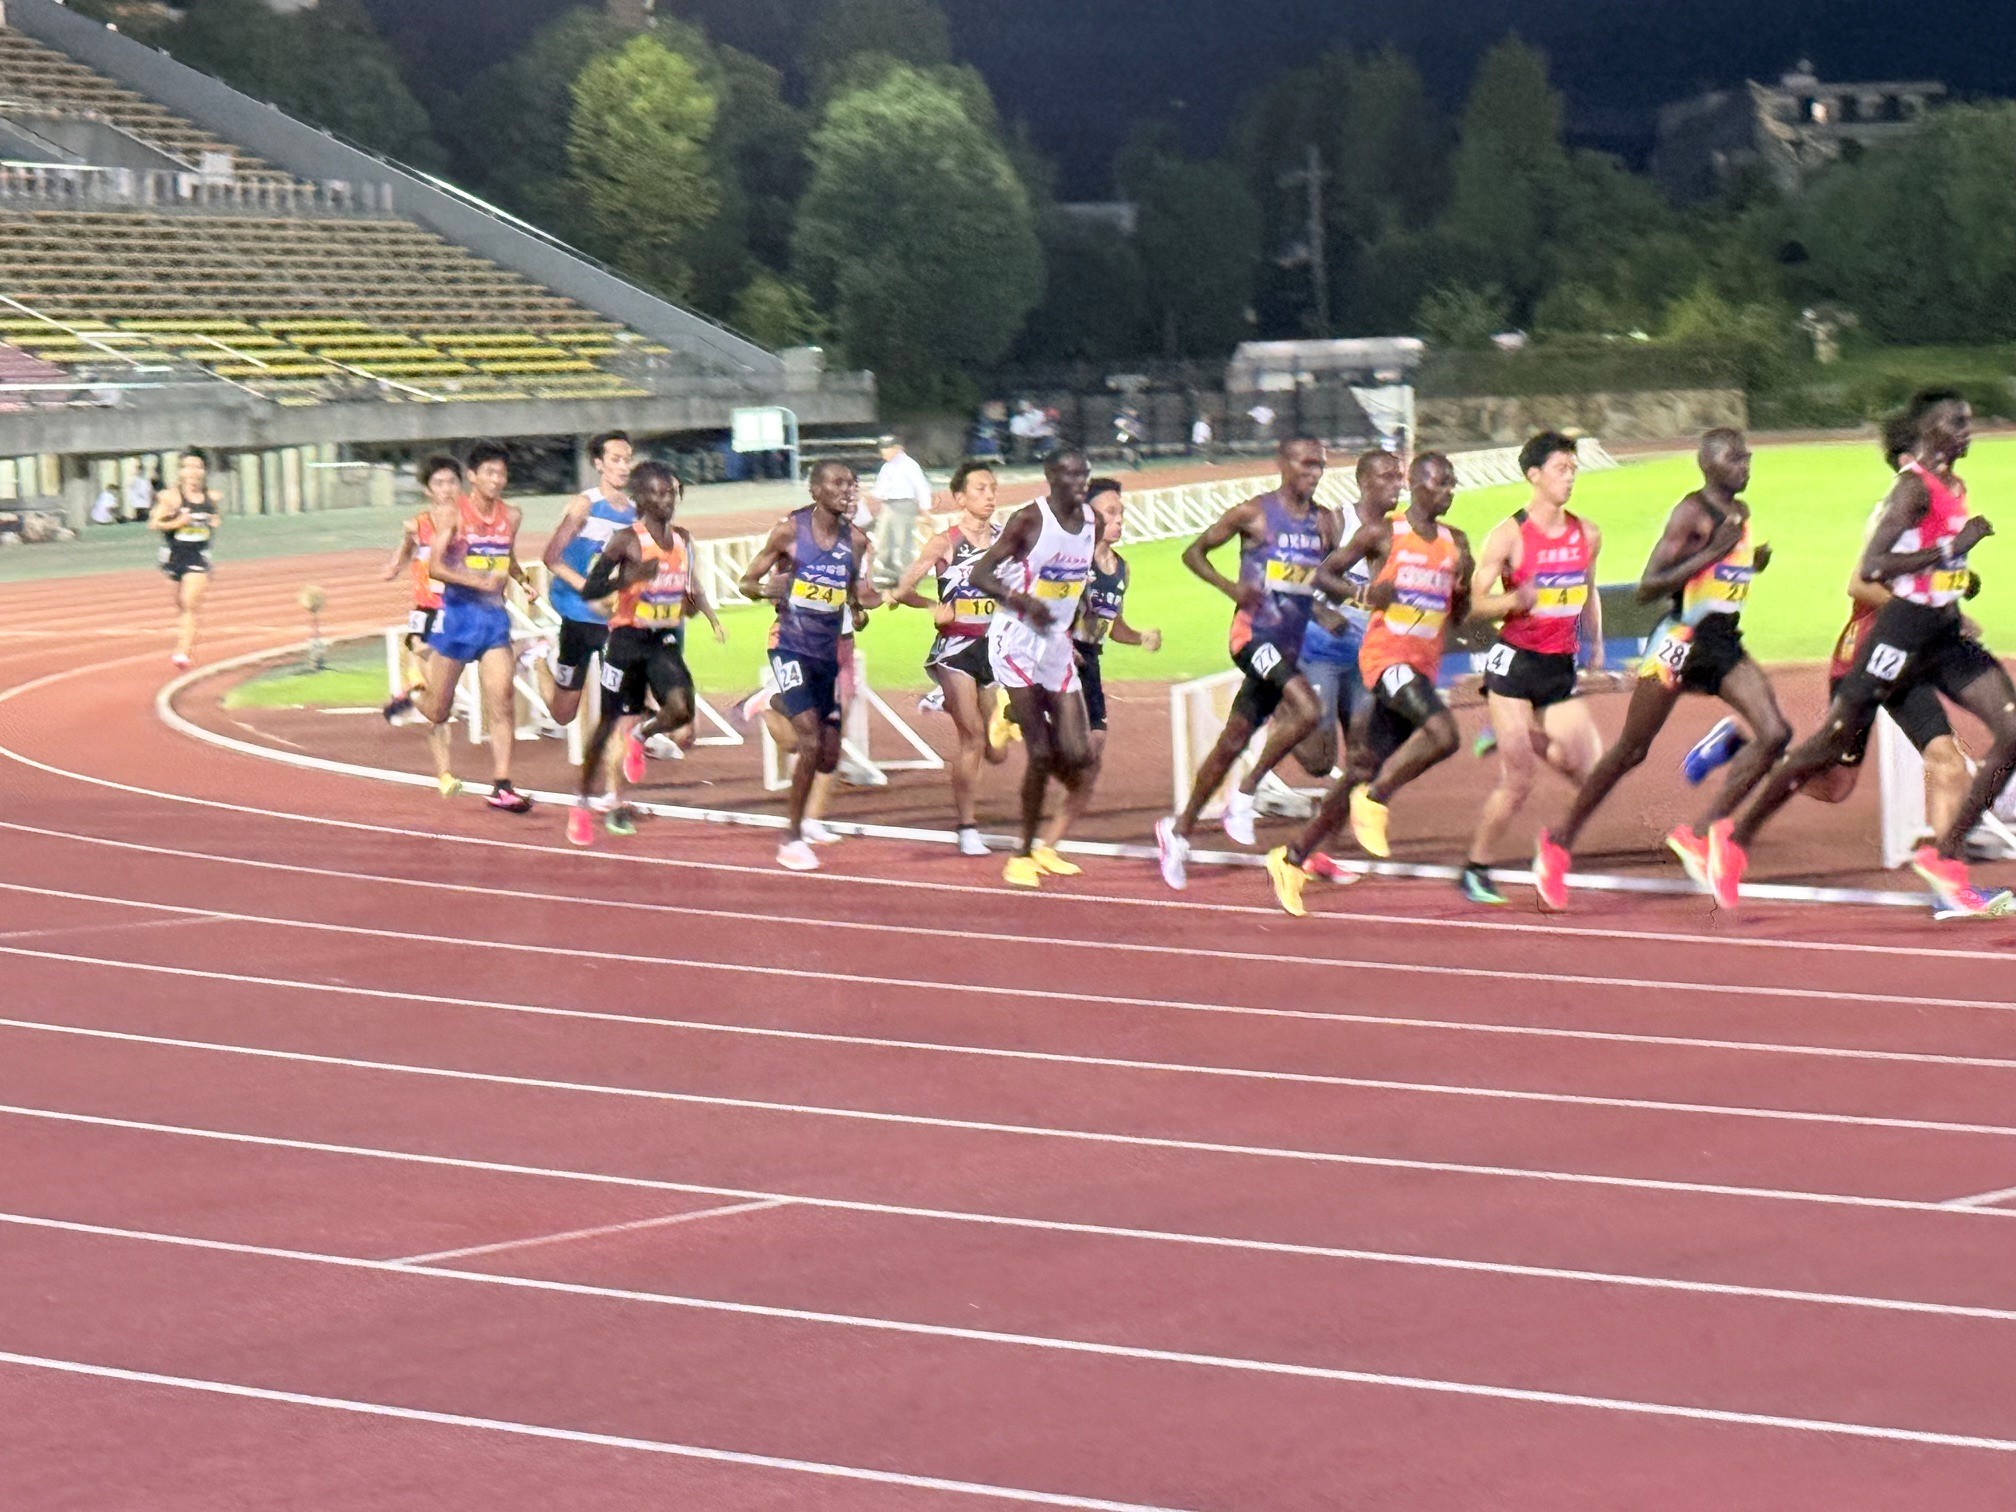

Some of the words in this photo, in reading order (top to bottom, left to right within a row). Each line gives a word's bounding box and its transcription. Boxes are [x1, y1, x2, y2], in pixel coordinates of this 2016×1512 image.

[805, 584, 833, 604] 24
[1060, 582, 1070, 598] 3
[1557, 588, 1568, 606] 4
[972, 600, 995, 615] 10
[1492, 648, 1505, 670] 4
[1658, 638, 1685, 669] 28
[780, 664, 801, 688] 24
